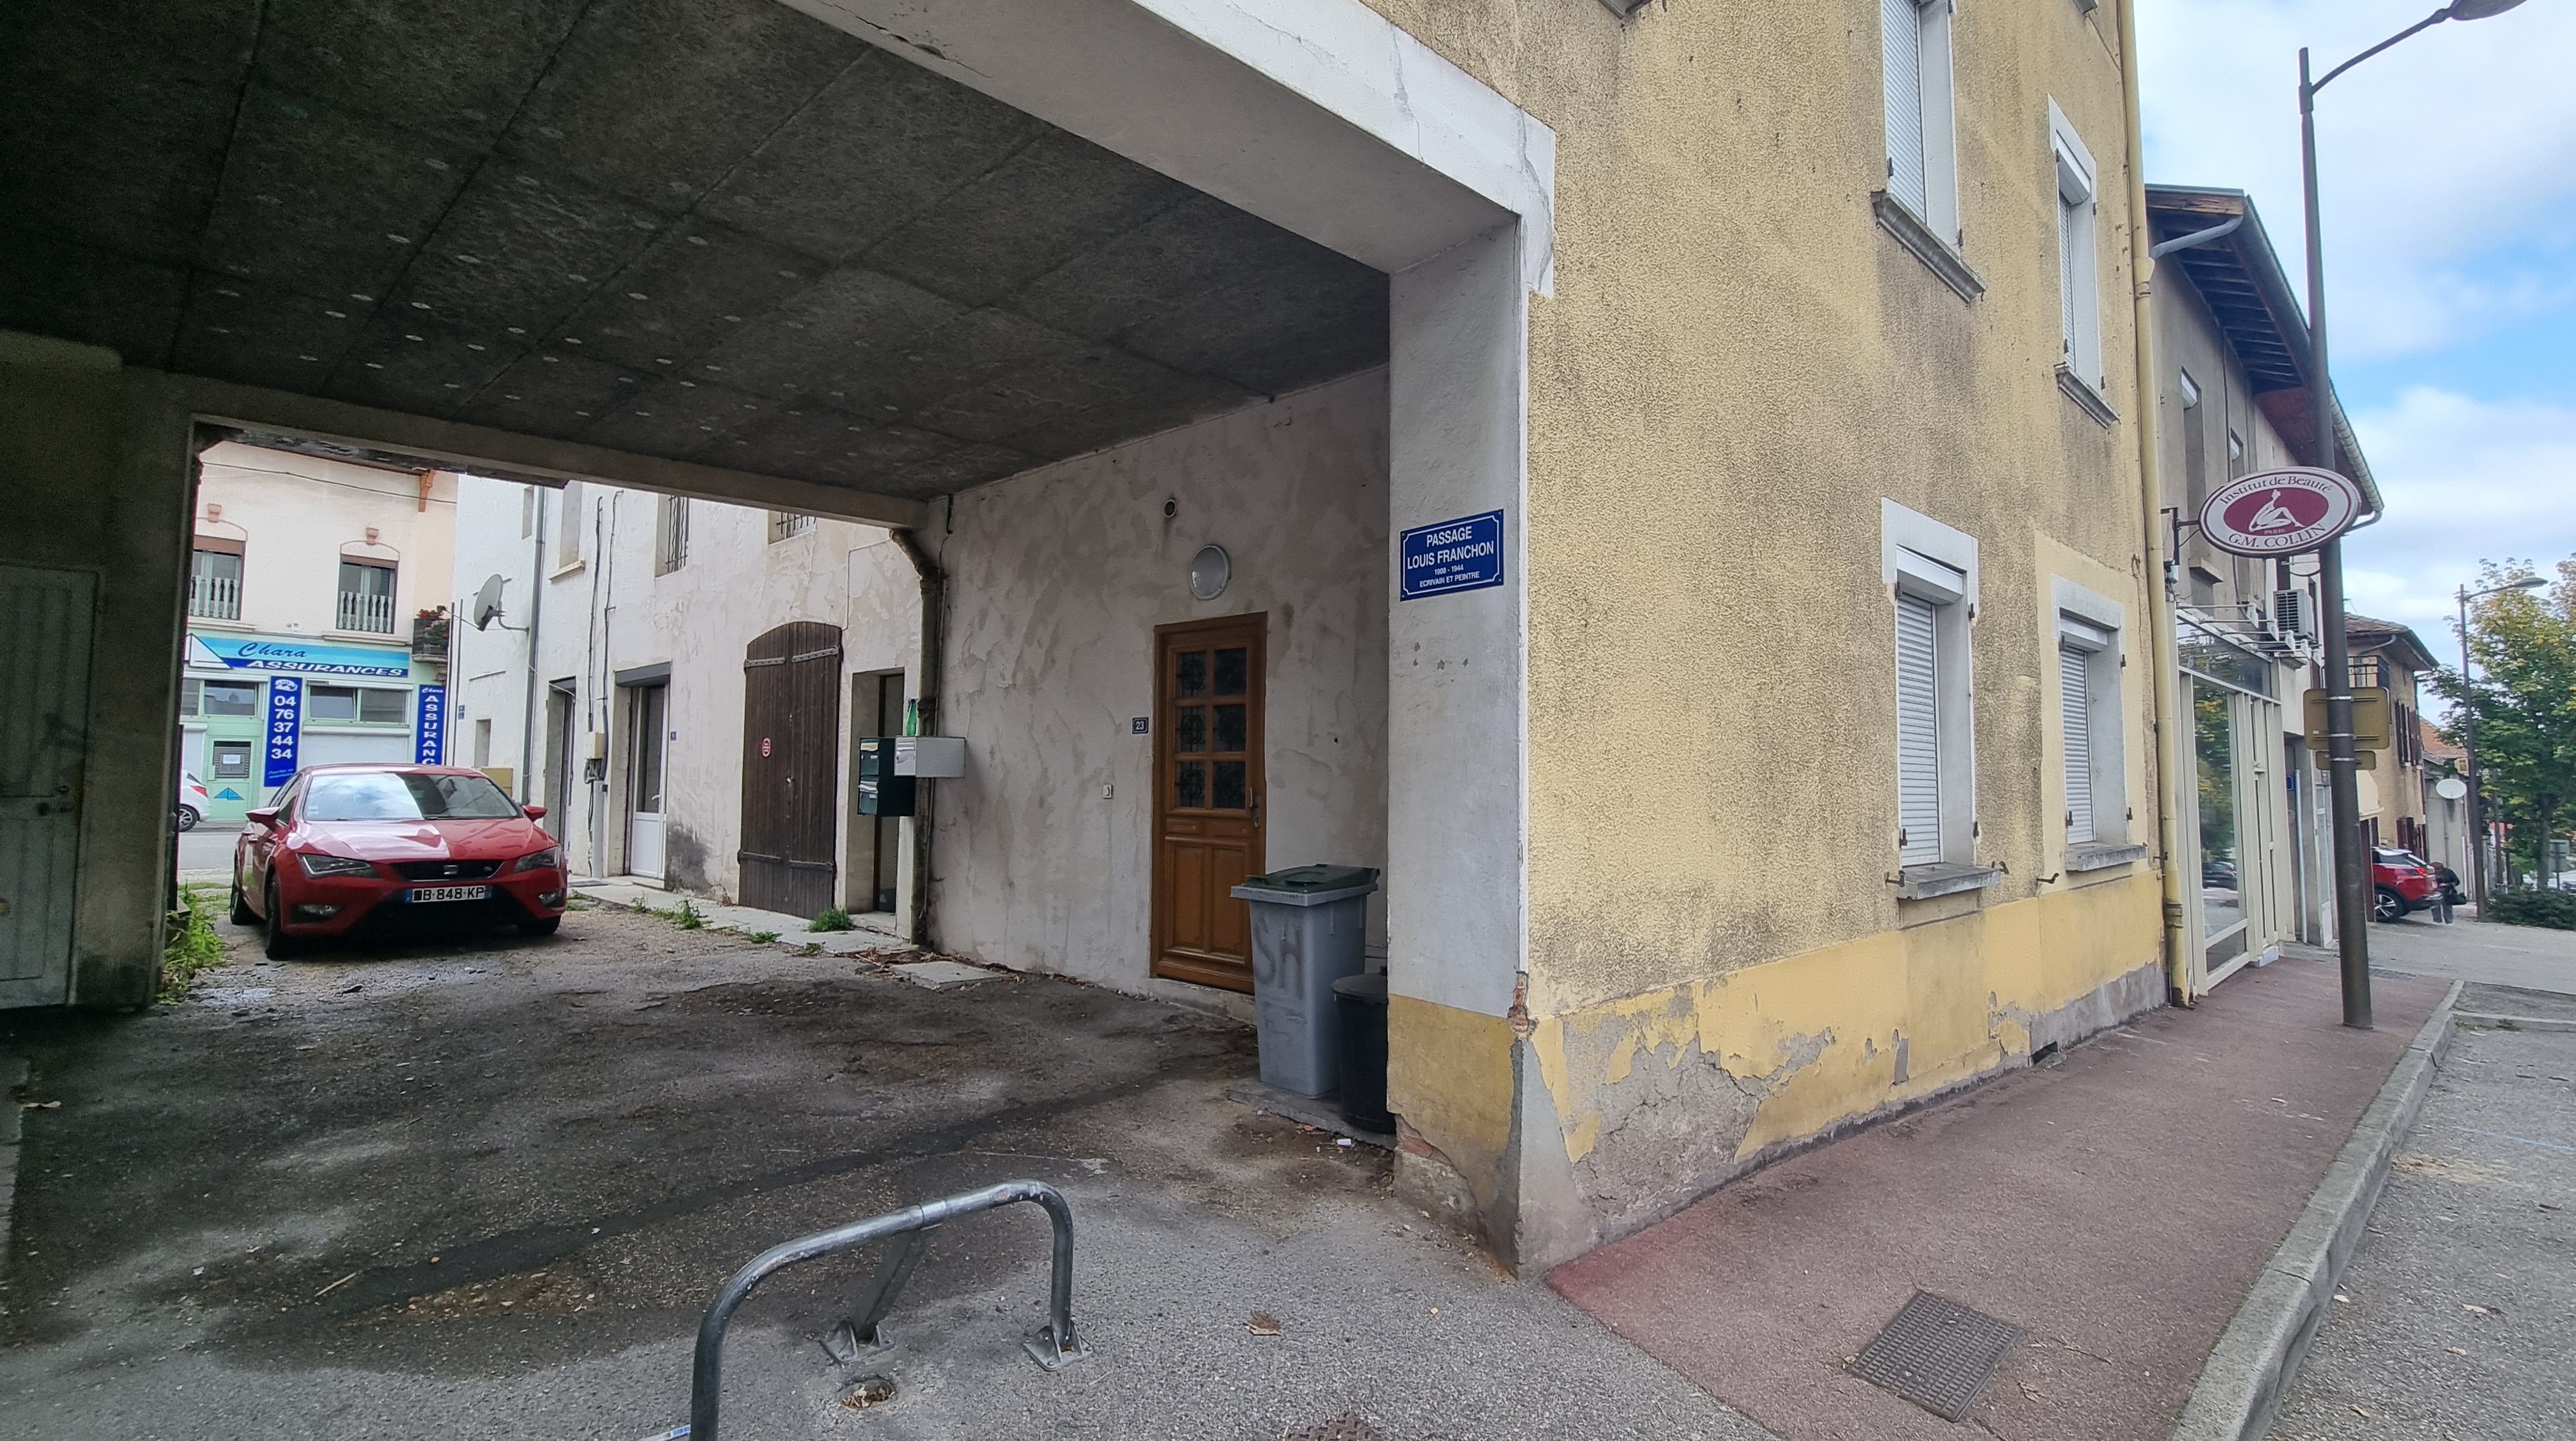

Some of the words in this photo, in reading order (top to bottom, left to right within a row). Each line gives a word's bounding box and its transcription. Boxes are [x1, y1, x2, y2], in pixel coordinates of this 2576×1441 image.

[2220, 479, 2267, 505] Institut
[2269, 477, 2285, 486] de
[2287, 475, 2333, 493] Beauté
[1427, 526, 1472, 547] PASSAGE
[2228, 533, 2260, 547] G.M.
[2264, 522, 2327, 548] COLLIN
[1407, 552, 1435, 569] LOUIS
[1438, 540, 1494, 564] FRANCHON
[1451, 564, 1464, 572] 1944
[1420, 577, 1445, 588] ECRIVAIN
[1455, 571, 1480, 582] PEINTRE
[238, 642, 307, 658] Chara
[247, 660, 402, 676] ASSURANCES
[274, 696, 296, 706] 04
[275, 709, 295, 719] 76
[273, 722, 294, 733] 37
[1136, 721, 1144, 730] 23
[272, 735, 293, 745] 44
[271, 749, 293, 759] 34
[413, 887, 484, 901] B-848-KP
